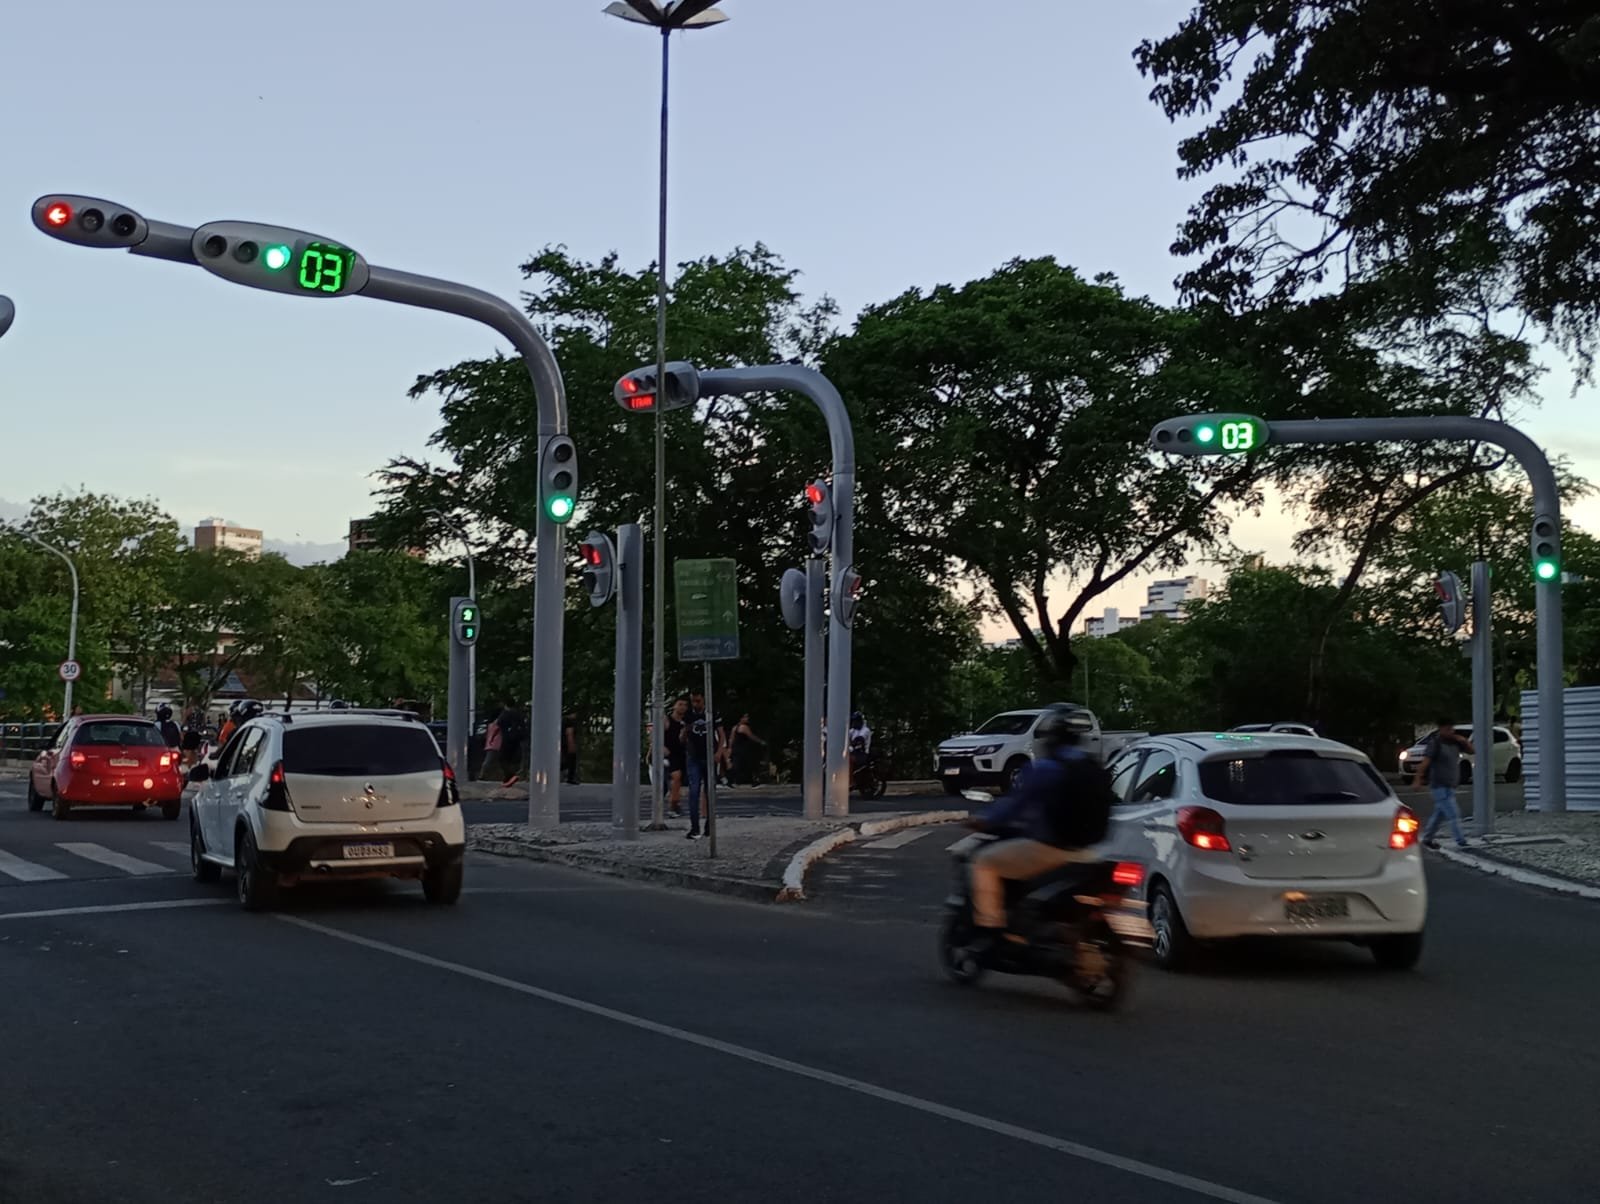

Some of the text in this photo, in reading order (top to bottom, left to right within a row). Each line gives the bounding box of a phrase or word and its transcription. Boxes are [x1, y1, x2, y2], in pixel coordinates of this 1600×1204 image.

[300, 250, 342, 292] 03
[1222, 422, 1253, 449] 03
[63, 664, 76, 674] 30
